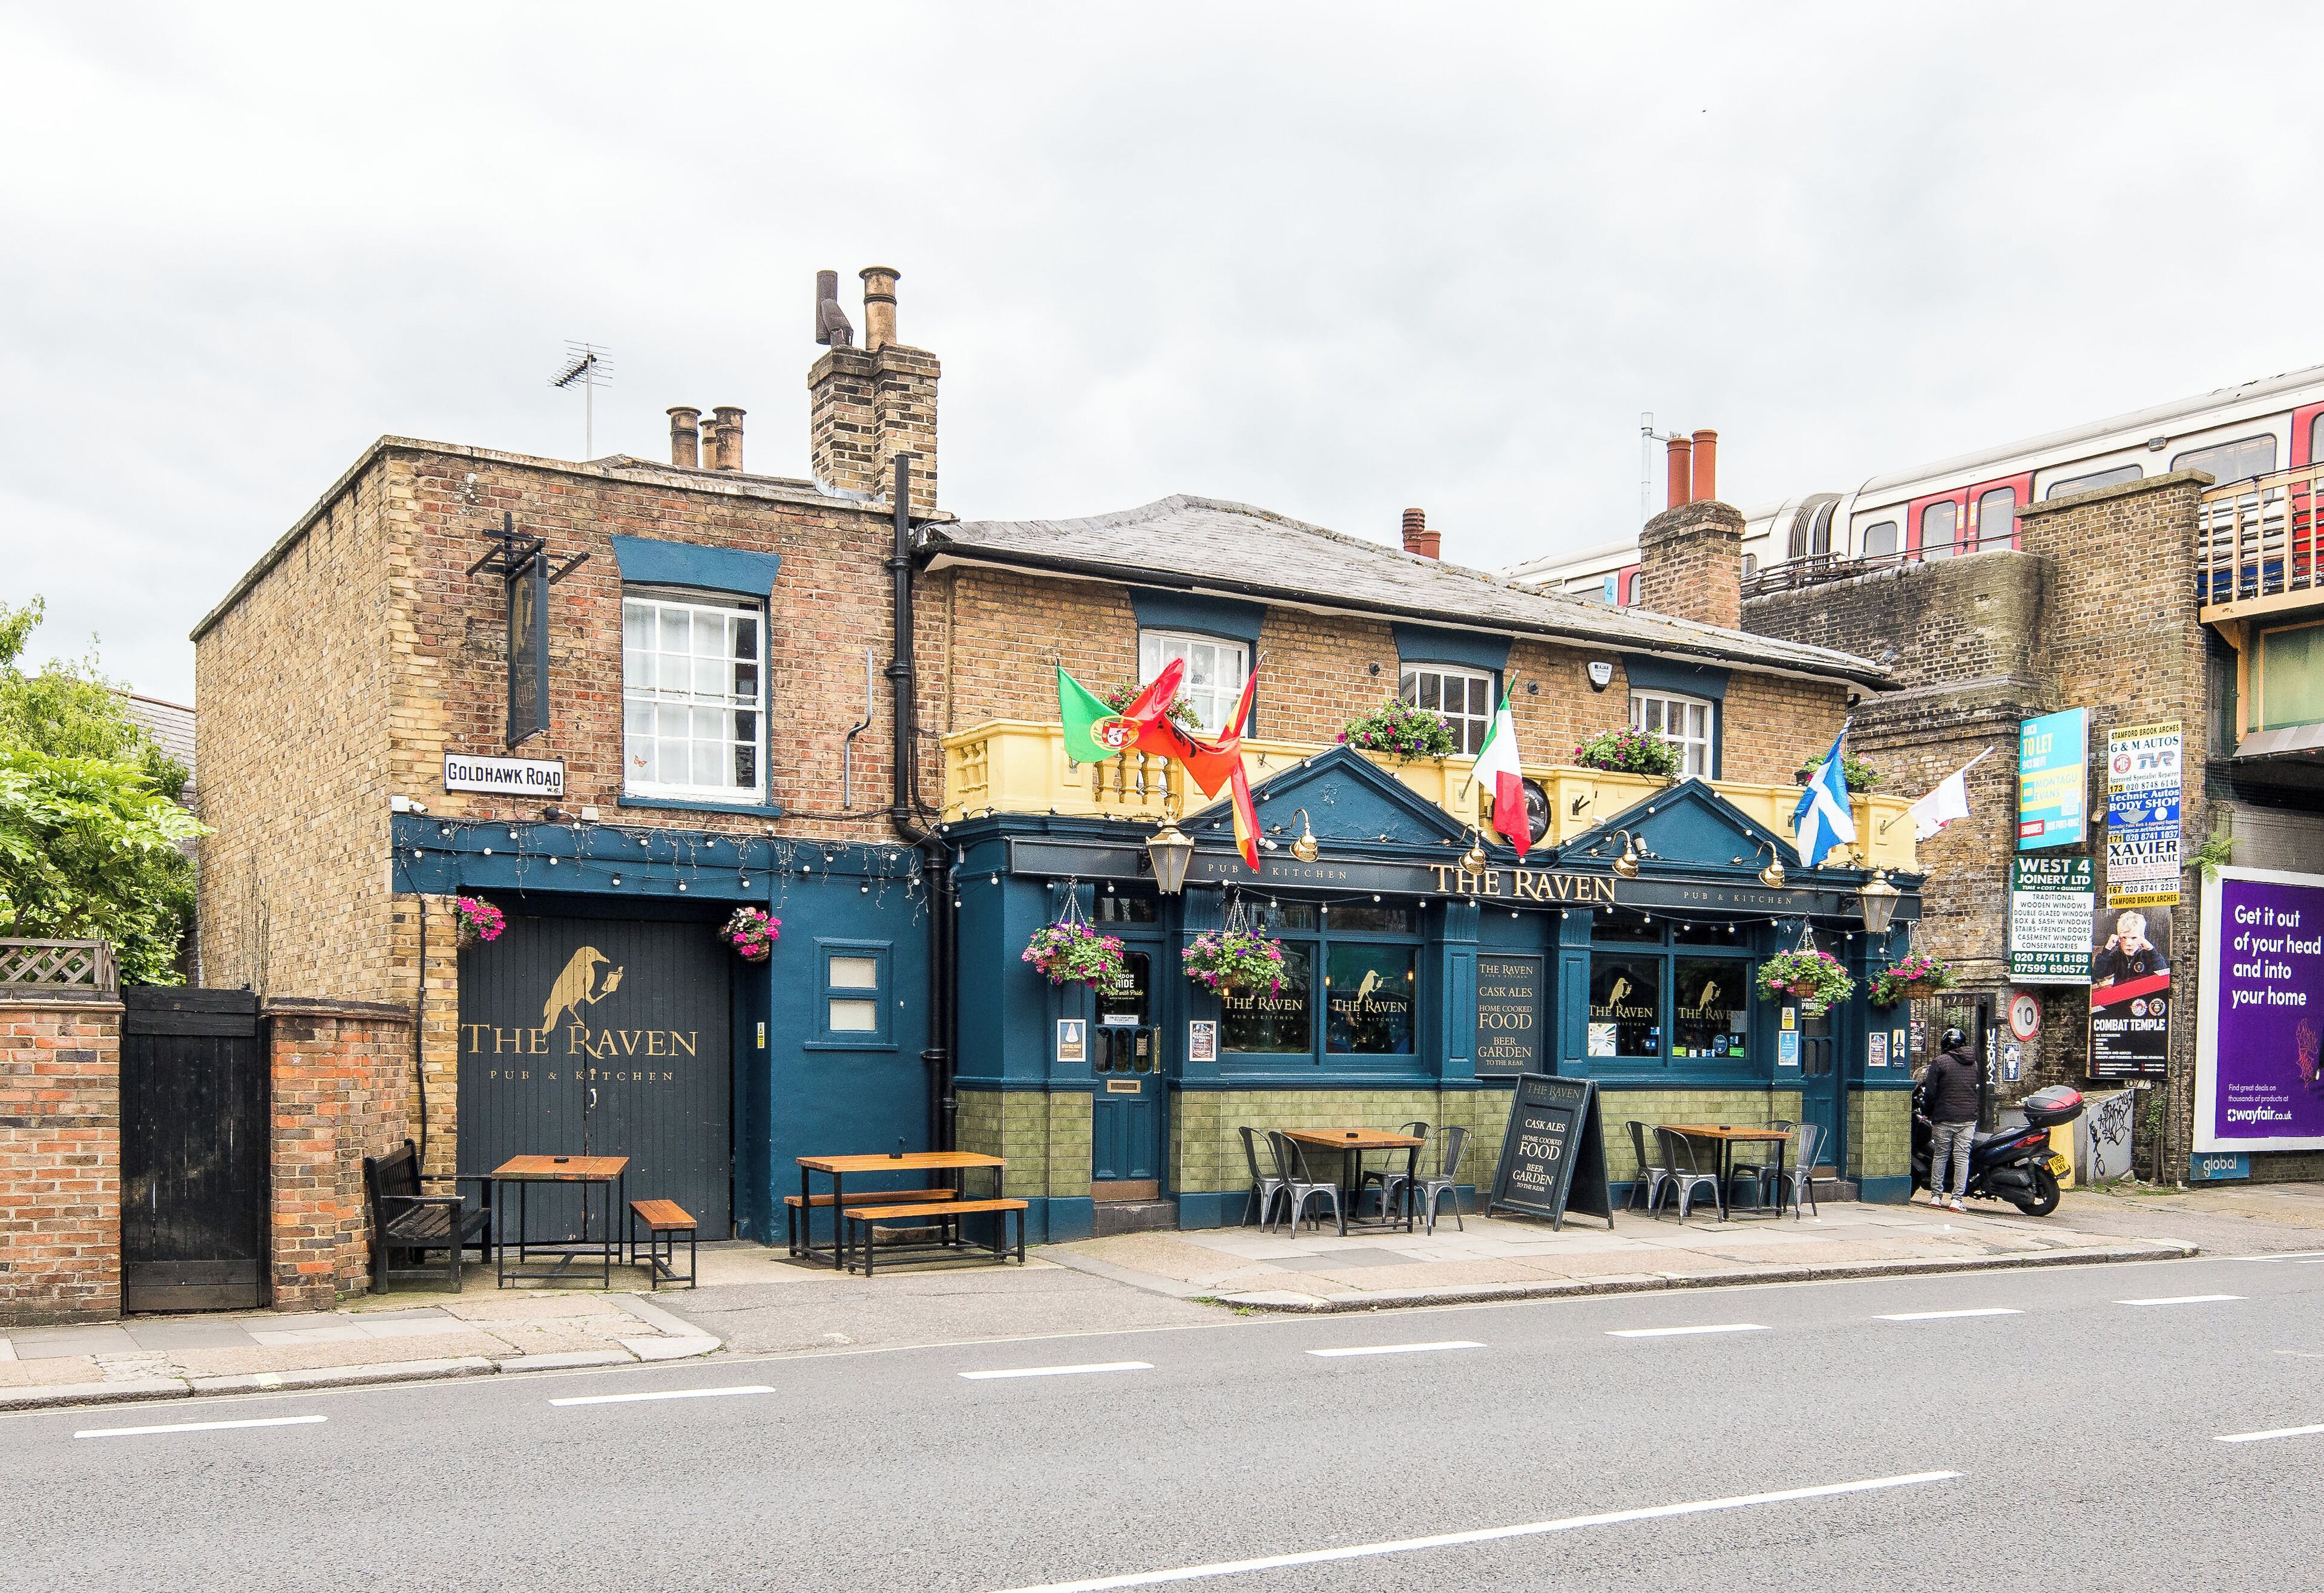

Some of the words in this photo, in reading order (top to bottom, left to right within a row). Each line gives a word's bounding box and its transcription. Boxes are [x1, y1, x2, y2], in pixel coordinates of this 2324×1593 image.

[2112, 730, 2138, 740] STAMFORD
[2139, 728, 2158, 736] BROOK
[2159, 724, 2179, 733] ARCHES
[2023, 737, 2035, 758] TO
[2036, 733, 2053, 755] LET
[2110, 743, 2118, 752] G
[2121, 742, 2128, 751] &
[2132, 740, 2140, 750] M
[2143, 735, 2179, 749] AUTOS
[2137, 751, 2175, 769] TVR
[448, 763, 522, 784] GOLDHAWK
[527, 767, 560, 786] ROAD
[2035, 773, 2078, 789] MONTAGU
[2035, 788, 2061, 801] EVANS
[2109, 792, 2149, 801] Technic
[2150, 789, 2179, 798] Autos
[2109, 800, 2142, 812] BODY
[2145, 797, 2179, 809] SHOP
[2141, 832, 2158, 840] 8741
[2160, 830, 2178, 839] 1037
[2109, 840, 2177, 857] XAVIER
[2018, 858, 2072, 873] WEST
[2077, 859, 2090, 873] 4
[2109, 857, 2138, 866] AUTO
[2143, 854, 2178, 864] CLINIC
[1208, 864, 1239, 873] PUB
[1273, 867, 1347, 879] KITCHEN
[1430, 864, 1500, 896] THE
[1513, 870, 1617, 902] RAVEN
[2017, 874, 2069, 884] JOINERY
[2071, 875, 2091, 885] LTD
[1683, 891, 1708, 900] PUB
[1733, 894, 1793, 905] KITCHEN
[2109, 896, 2135, 905] STAMFORD
[2234, 904, 2261, 925] Get
[2264, 907, 2274, 925] it
[2277, 910, 2300, 927] out
[2234, 931, 2250, 951] of
[2251, 938, 2284, 957] your
[2286, 934, 2321, 954] head
[2014, 953, 2034, 962] 020
[2035, 953, 2060, 962] 8741
[2063, 954, 2089, 963] 8188
[1479, 964, 1499, 974] THE
[1503, 964, 1533, 974] RAVEN
[2014, 964, 2046, 973] 07599
[2049, 964, 2089, 974] 690577
[2233, 959, 2261, 978] and
[2264, 959, 2292, 979] into
[1479, 987, 1506, 997] CASK
[1508, 987, 1532, 997] ALES
[2232, 990, 2265, 1009] your
[2268, 985, 2306, 1006] home
[1223, 996, 1253, 1010] THE
[1258, 997, 1303, 1011] RAVEN
[1333, 999, 1360, 1012] THE
[1365, 1000, 1407, 1014] RAVEN
[1589, 1005, 1612, 1017] THE
[1616, 1005, 1653, 1019] RAVEN
[1678, 1007, 1701, 1019] THE
[1705, 1007, 1741, 1020] RAVEN
[2017, 1007, 2034, 1026] 10
[1479, 1013, 1532, 1030] FOOD
[2093, 1019, 2129, 1031] COMBAT
[2130, 1019, 2165, 1031] TEMPLE
[461, 1023, 548, 1054] THE
[566, 1025, 698, 1059] RAVEN
[1493, 1037, 1517, 1045] BEER
[1478, 1046, 1532, 1057] GARDEN
[490, 1070, 530, 1080] PUB
[548, 1072, 557, 1080] &
[576, 1071, 673, 1081] KITCHEN
[1527, 1083, 1548, 1095] THE
[1549, 1085, 1580, 1099] RAVEN
[2240, 1085, 2254, 1093] great
[2260, 1095, 2283, 1103] products
[2236, 1106, 2293, 1124] wayfair.co.uk
[1525, 1119, 1546, 1130] CASK
[1546, 1122, 1566, 1132] ALES
[1521, 1134, 1538, 1143] HOME
[1538, 1137, 1563, 1146] COOKED
[1518, 1141, 1560, 1160] FOOD
[1526, 1163, 1544, 1173] BEER
[2202, 1154, 2237, 1177] global
[1512, 1170, 1554, 1186] GARDEN
